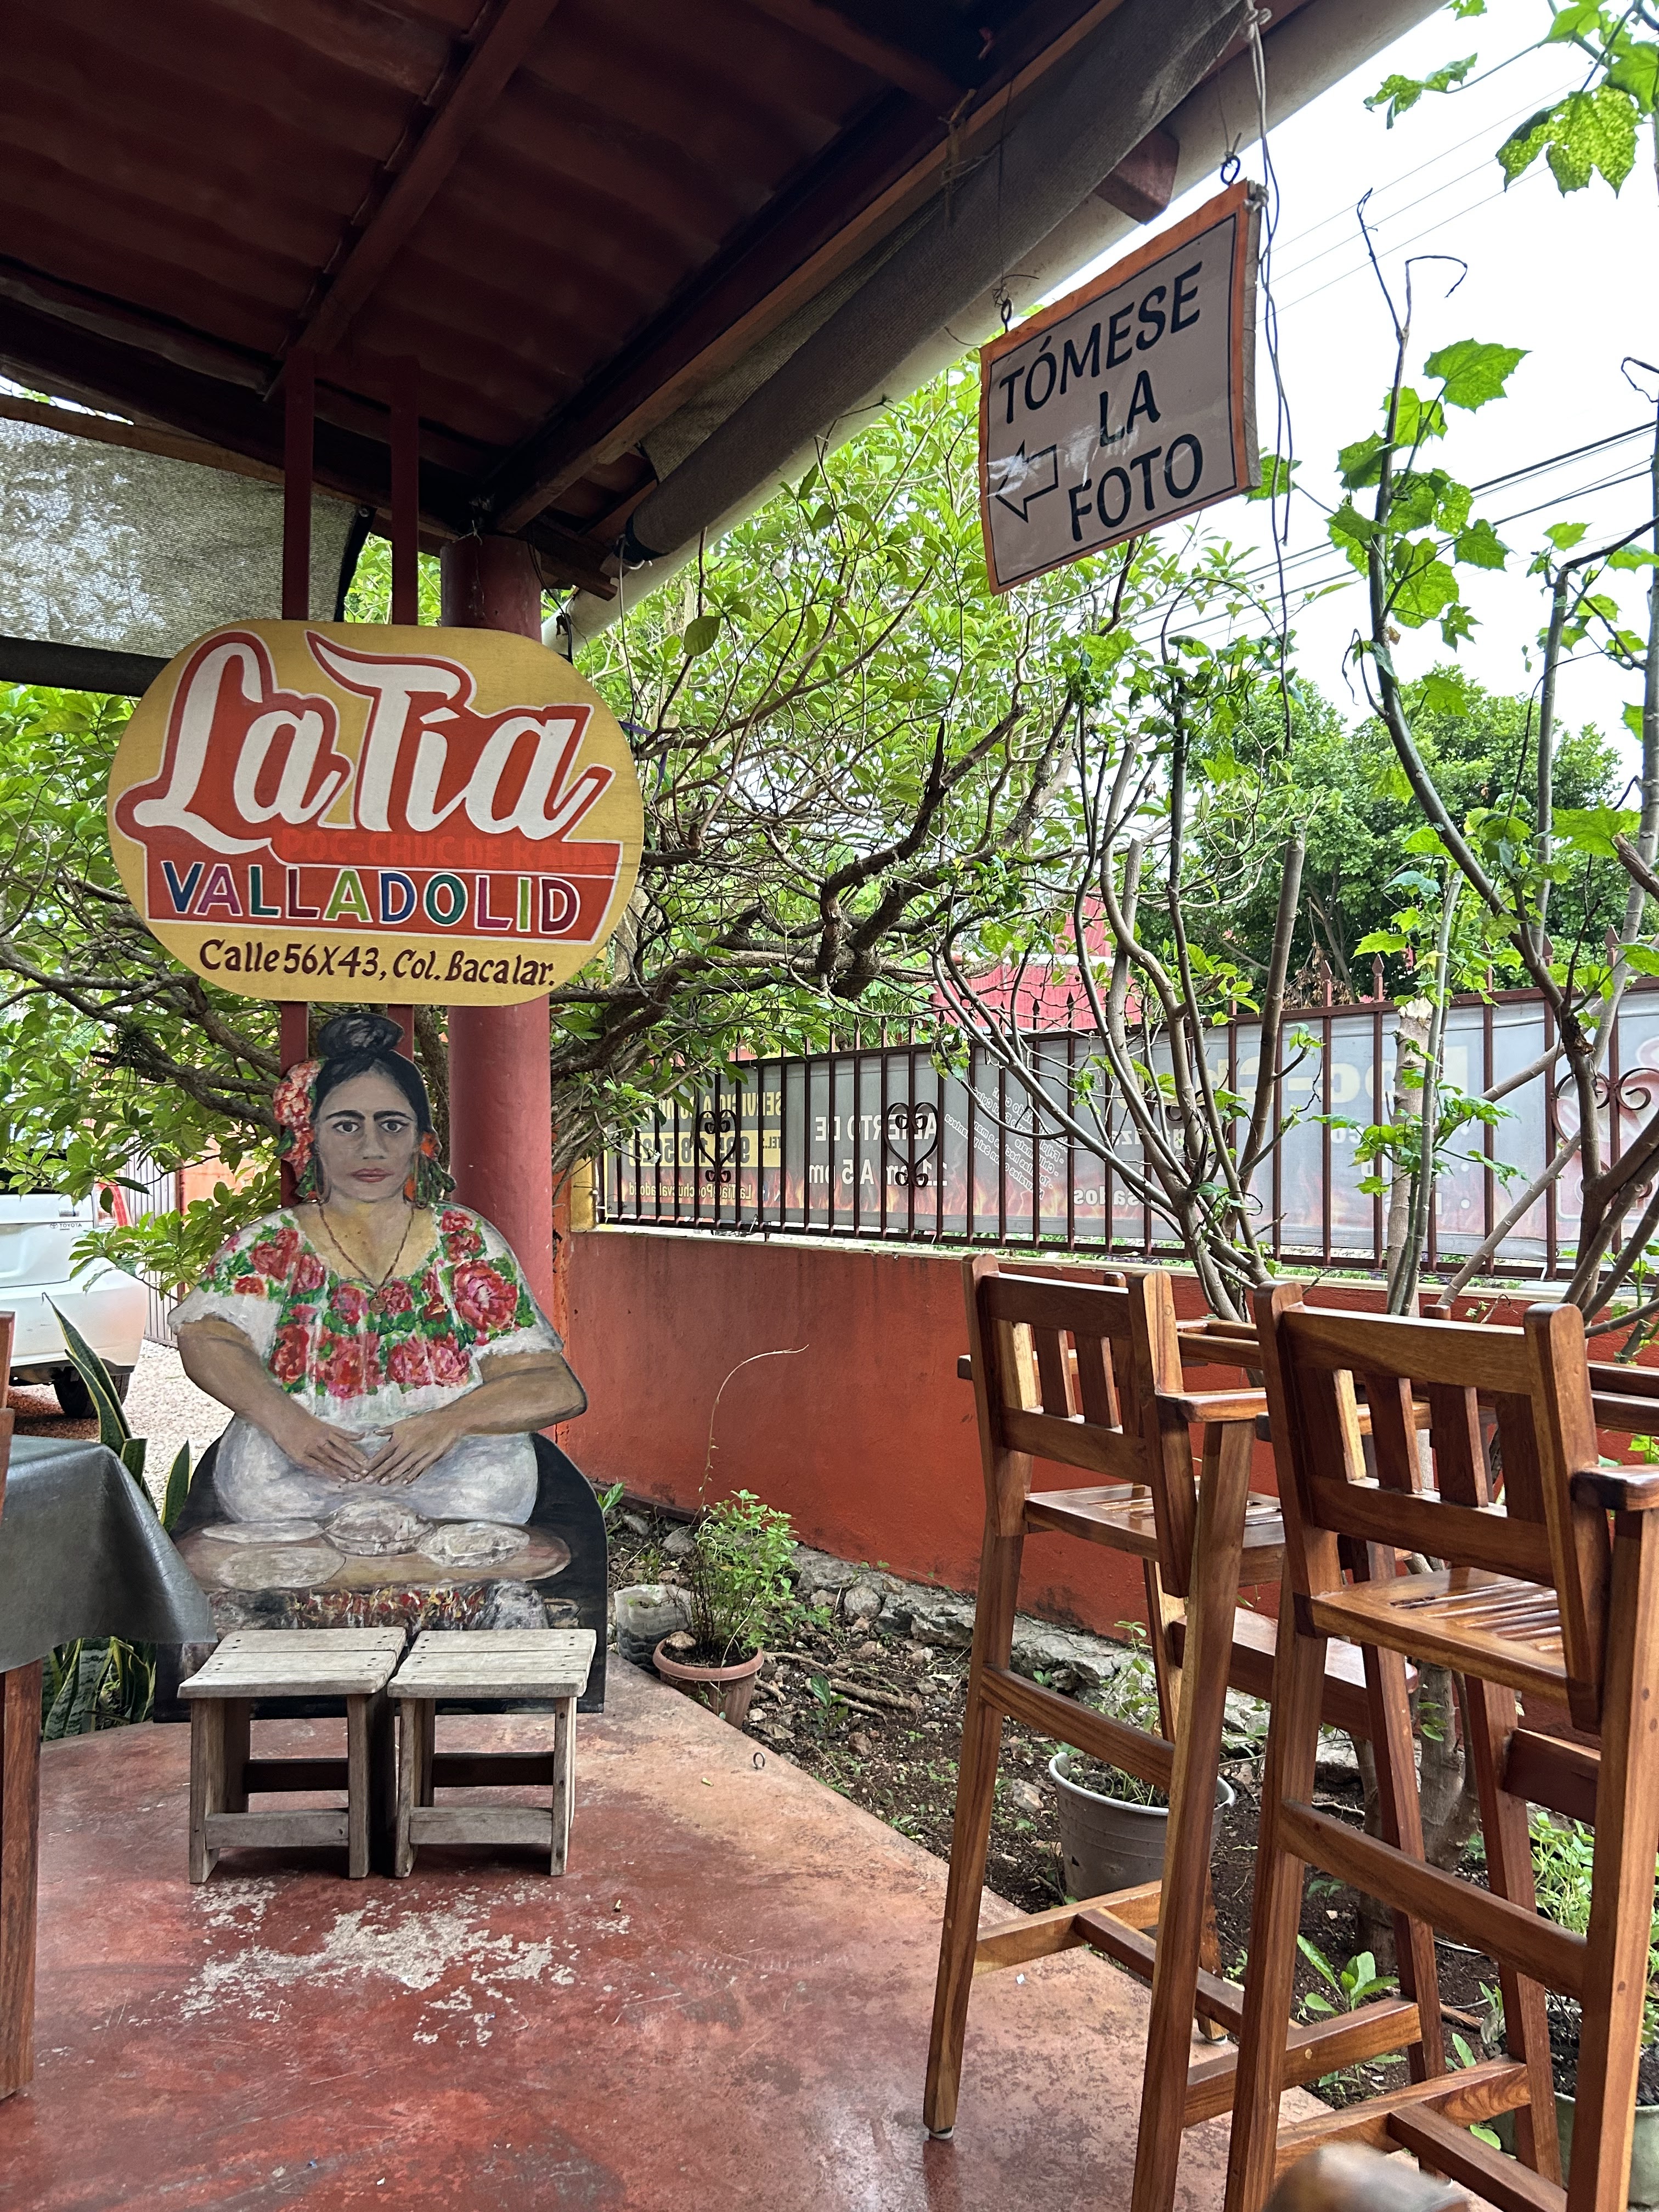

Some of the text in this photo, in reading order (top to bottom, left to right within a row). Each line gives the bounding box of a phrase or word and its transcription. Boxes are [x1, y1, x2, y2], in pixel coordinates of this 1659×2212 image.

[999, 261, 1203, 424] TÓMESE
[1099, 369, 1161, 448] LA
[1068, 433, 1203, 543] FOTO
[133, 631, 598, 855] La Tía
[160, 861, 582, 935] VALLADOLID
[200, 939, 280, 972] Calle
[393, 949, 441, 980] Col.
[444, 950, 555, 986] Bacalar.
